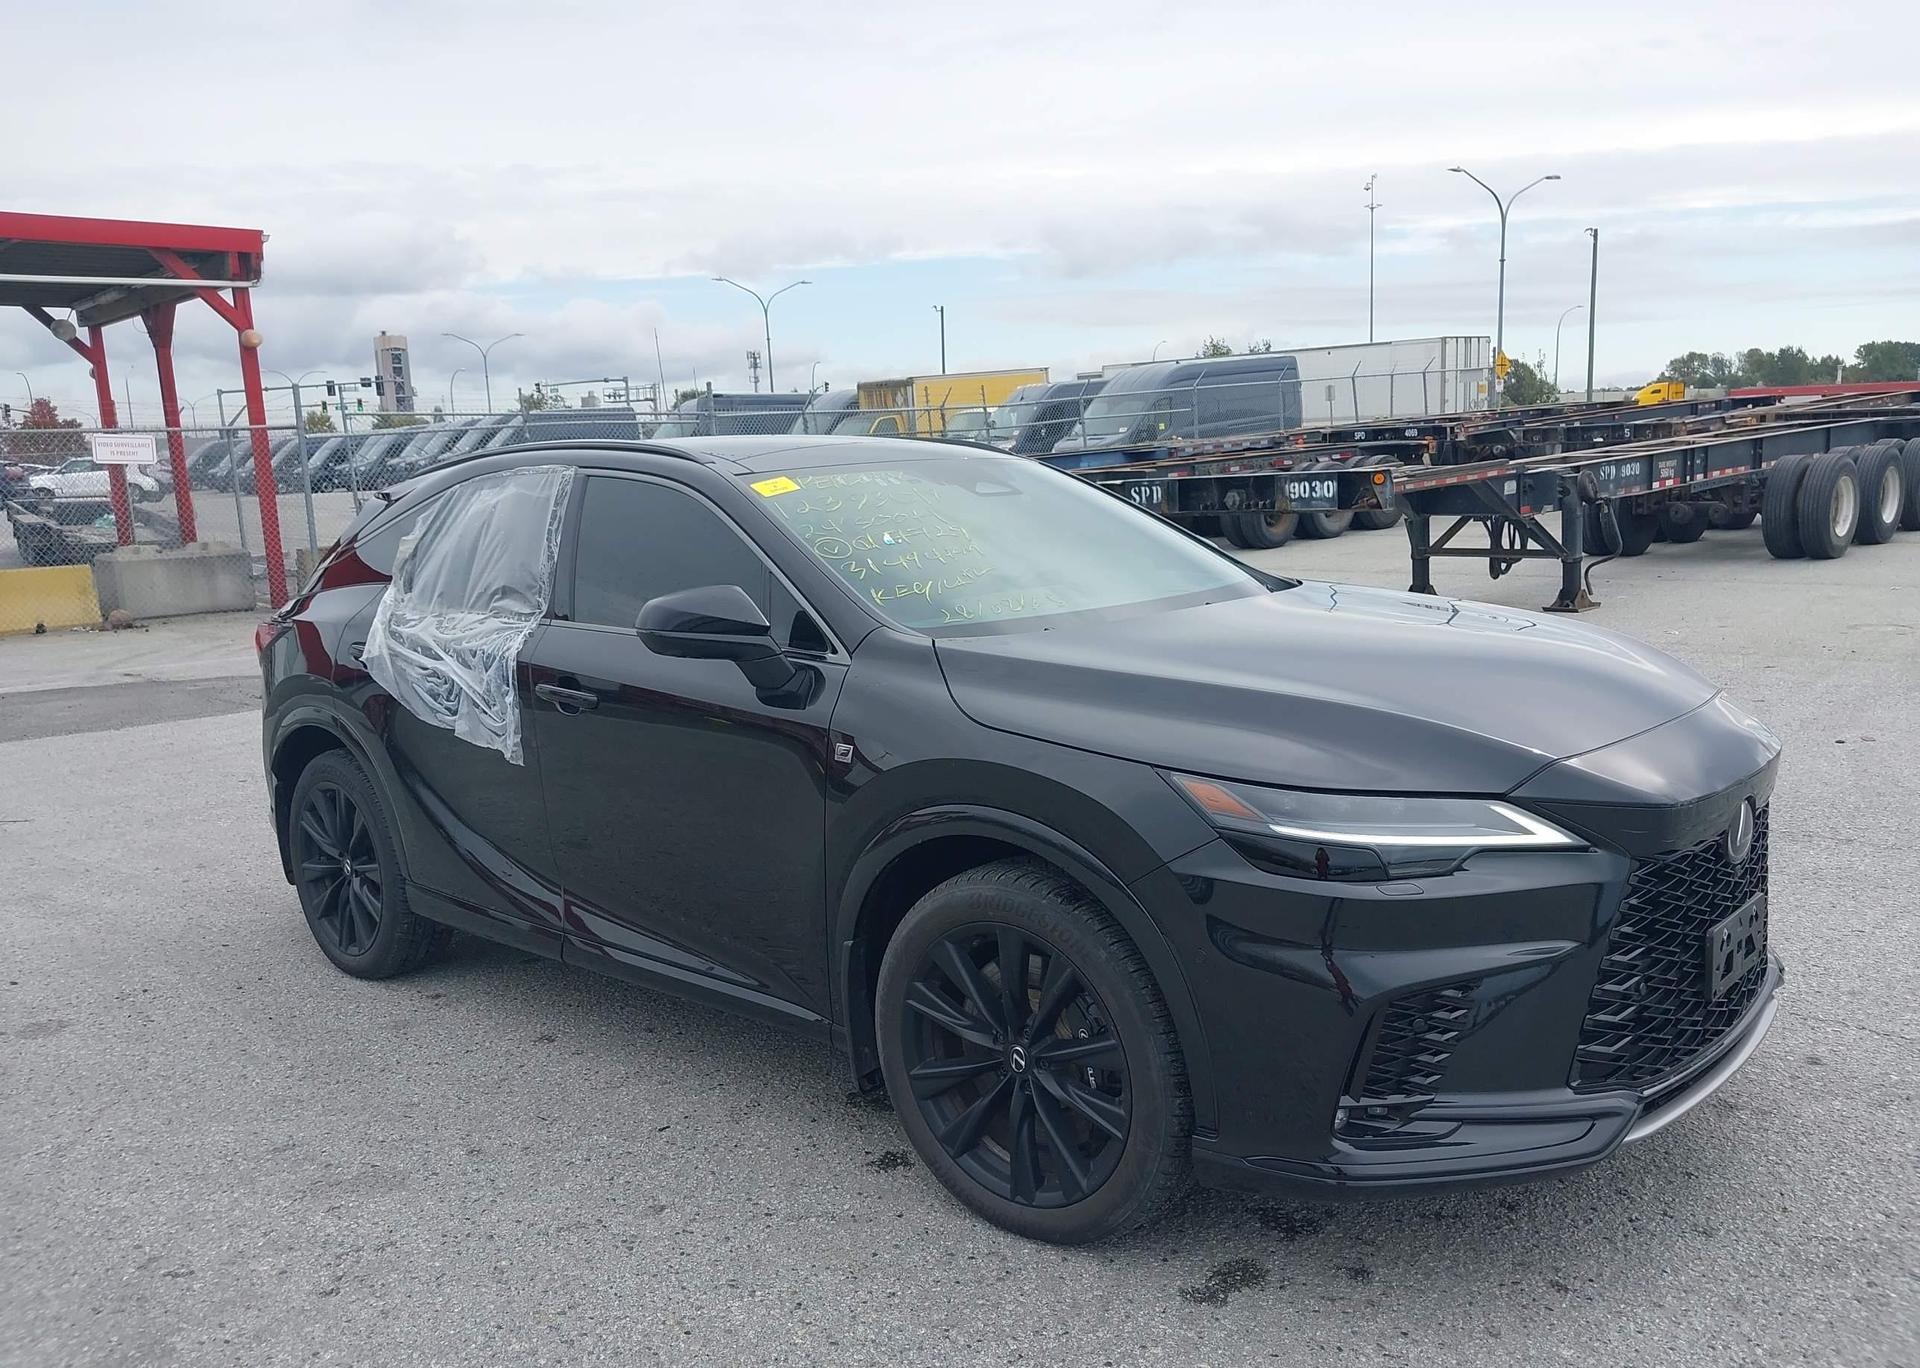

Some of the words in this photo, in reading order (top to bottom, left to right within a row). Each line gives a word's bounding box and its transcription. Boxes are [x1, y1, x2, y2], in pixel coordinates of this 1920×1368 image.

[1600, 465, 1616, 480] SPD
[1621, 461, 1640, 478] 9030
[1130, 485, 1162, 504] SPD
[1288, 480, 1335, 499] 9030
[967, 891, 1088, 958] BRIDGESTO
